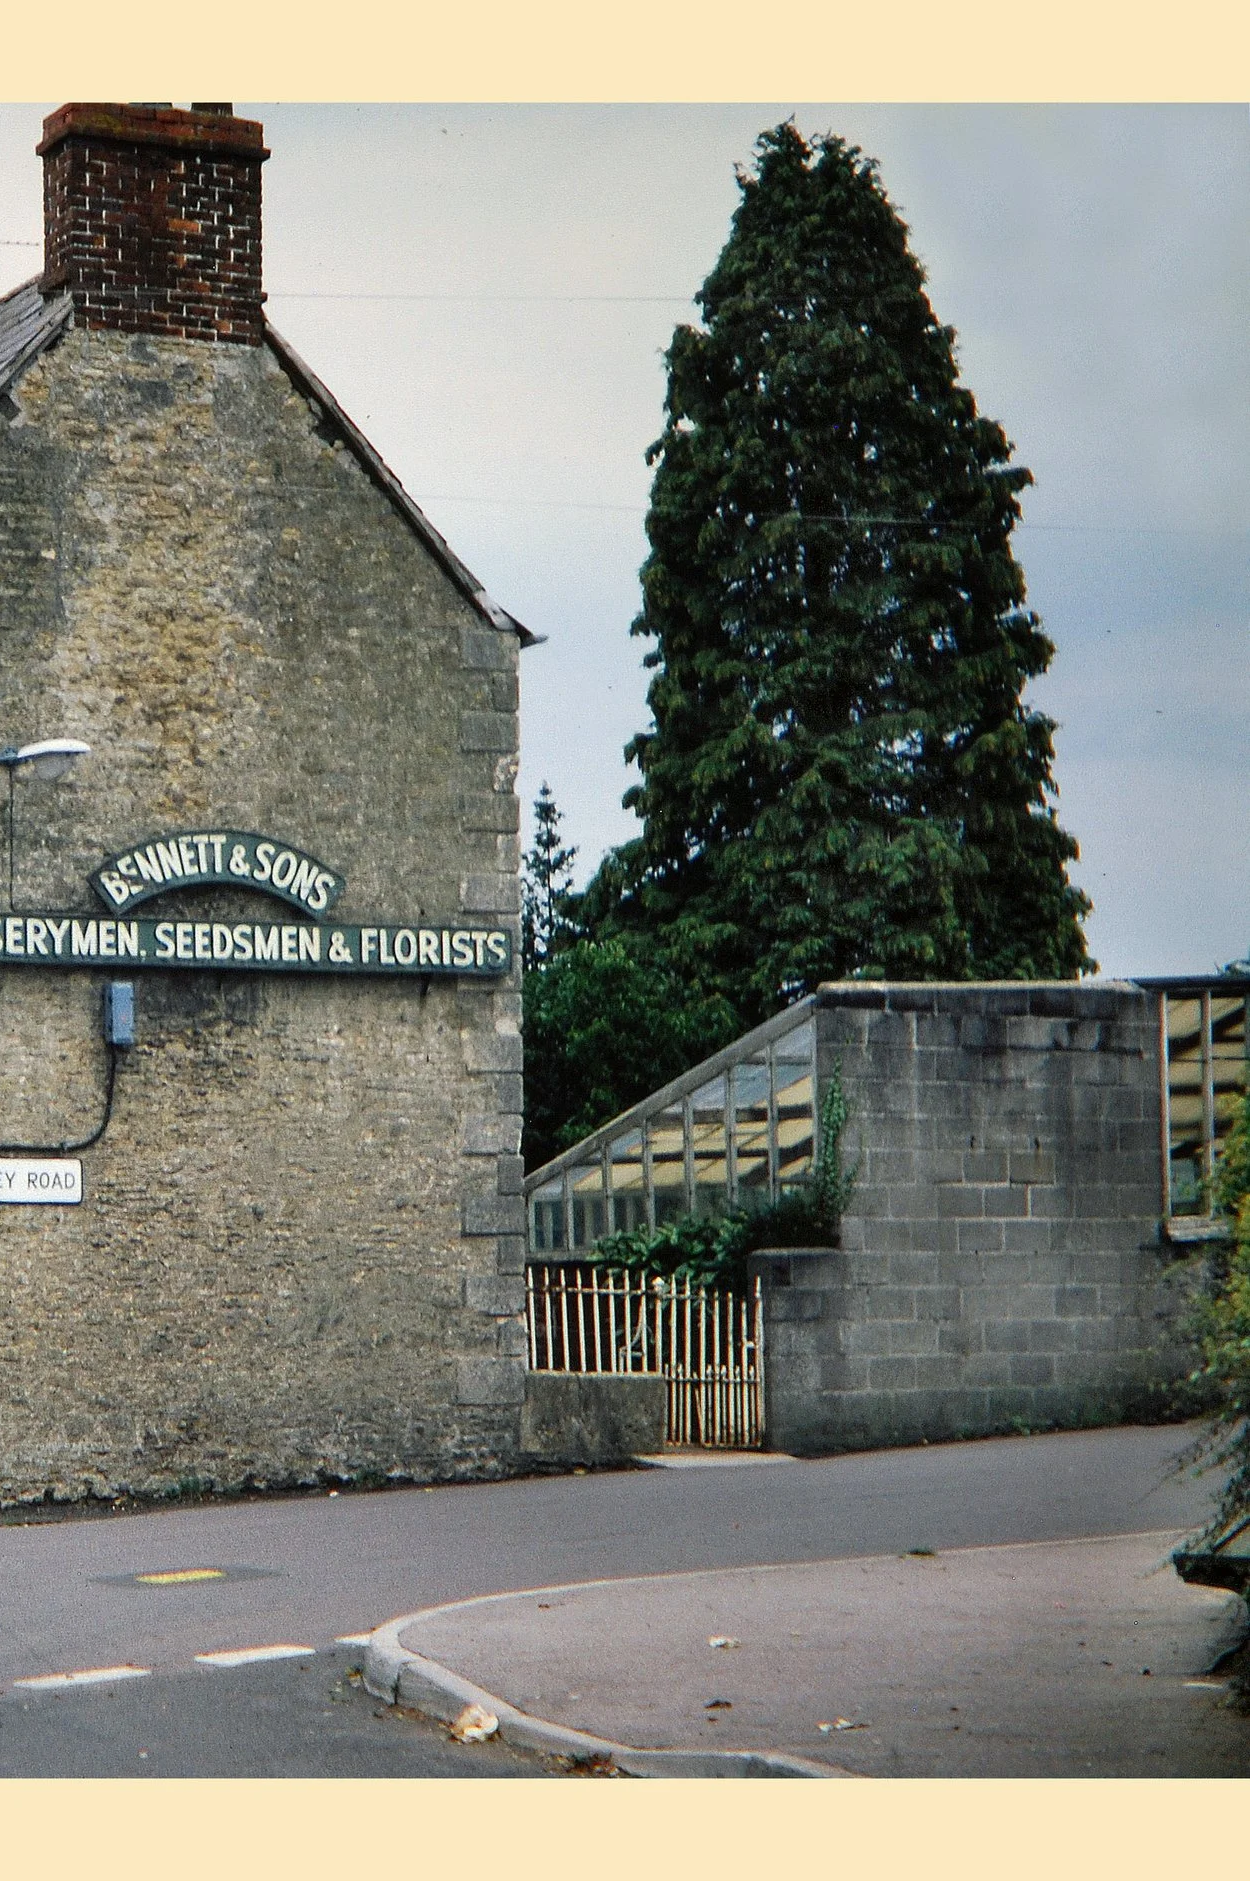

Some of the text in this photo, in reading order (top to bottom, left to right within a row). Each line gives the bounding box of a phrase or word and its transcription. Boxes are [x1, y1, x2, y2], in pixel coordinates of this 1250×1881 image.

[100, 834, 335, 909] BENNETT & SONS
[155, 922, 321, 962] SEEDSMEN
[328, 931, 353, 964] &
[361, 928, 507, 968] FLORISTS
[27, 1172, 76, 1190] ROAD
